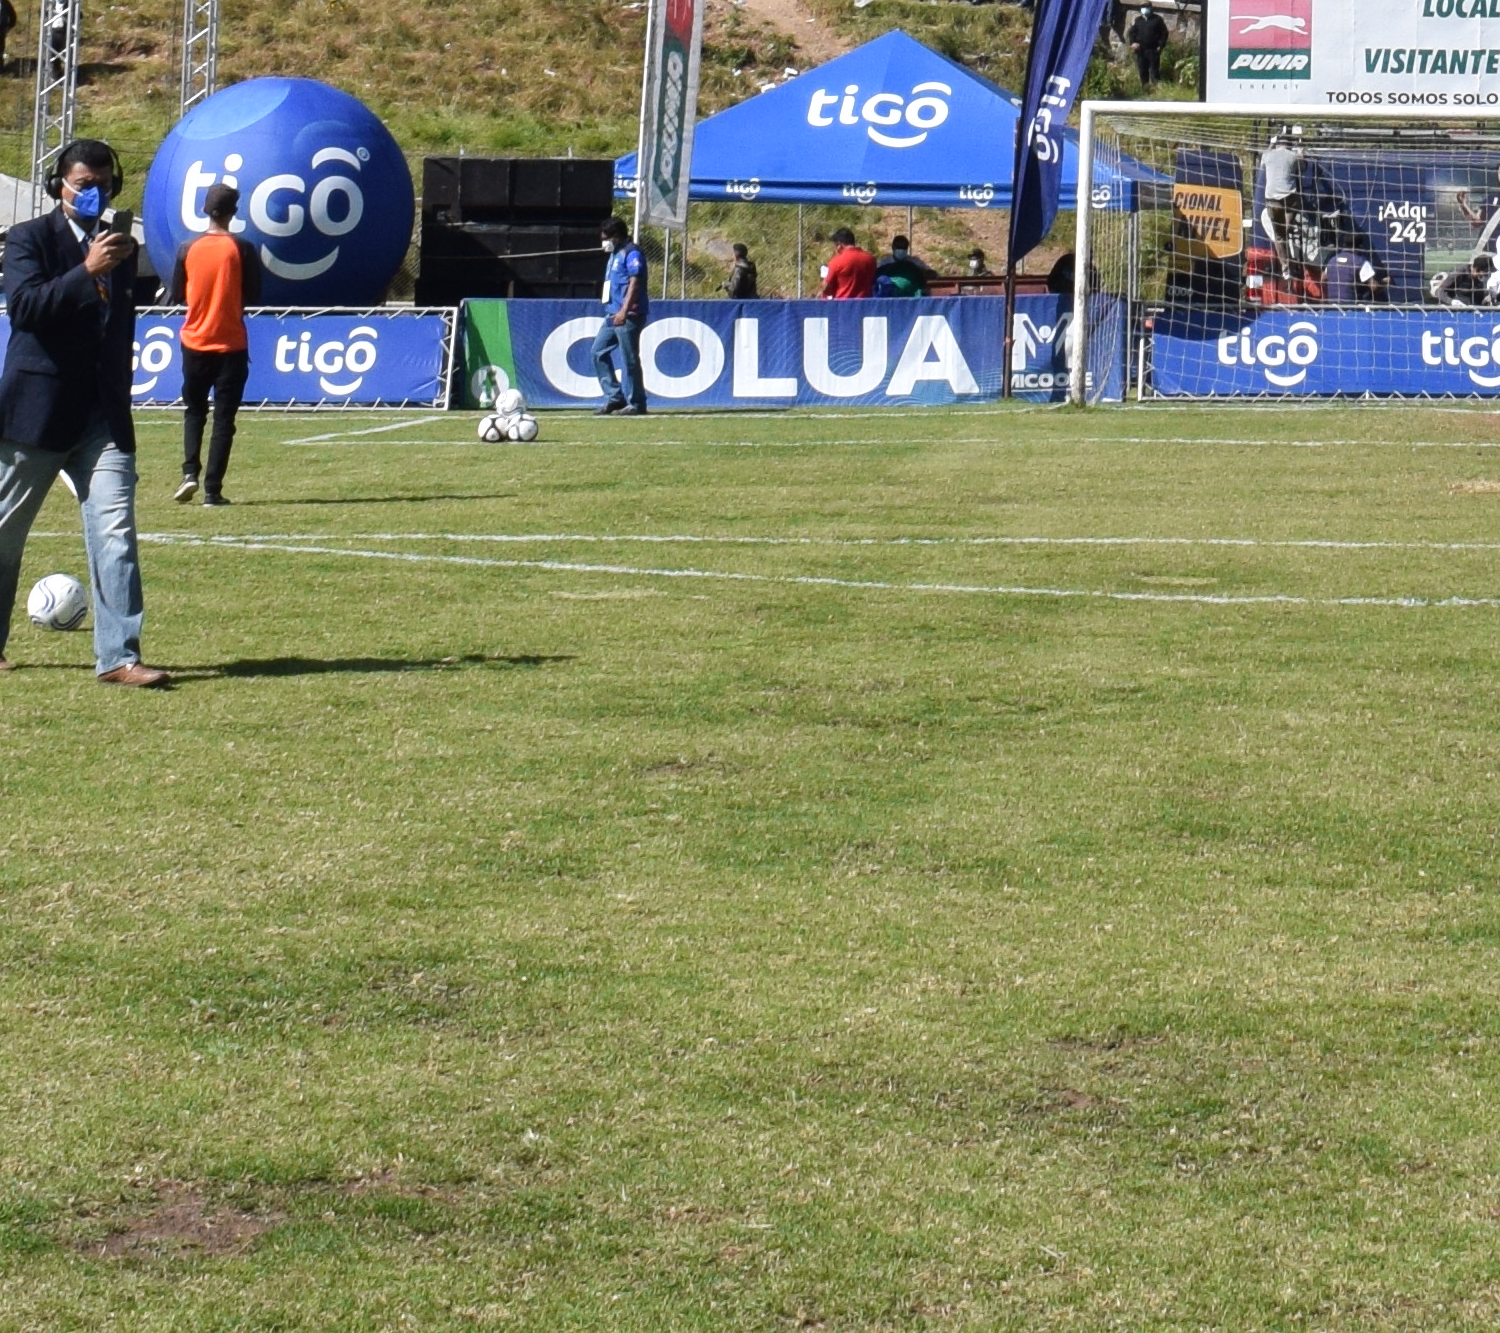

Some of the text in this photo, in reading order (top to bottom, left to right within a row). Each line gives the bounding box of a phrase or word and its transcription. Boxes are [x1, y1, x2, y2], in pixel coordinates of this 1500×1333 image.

[1231, 54, 1308, 72] PUMA
[1365, 48, 1500, 75] VISITANTE
[807, 81, 953, 129] tigo
[1326, 91, 1383, 104] TODOS
[1387, 92, 1448, 105] SOMOS
[725, 178, 761, 195] tigo
[842, 181, 877, 198] tigo
[959, 183, 995, 200] tigo
[1390, 221, 1426, 243] 242
[274, 325, 378, 374] tigo
[1218, 321, 1319, 367] tigo
[541, 315, 980, 399] COLUA
